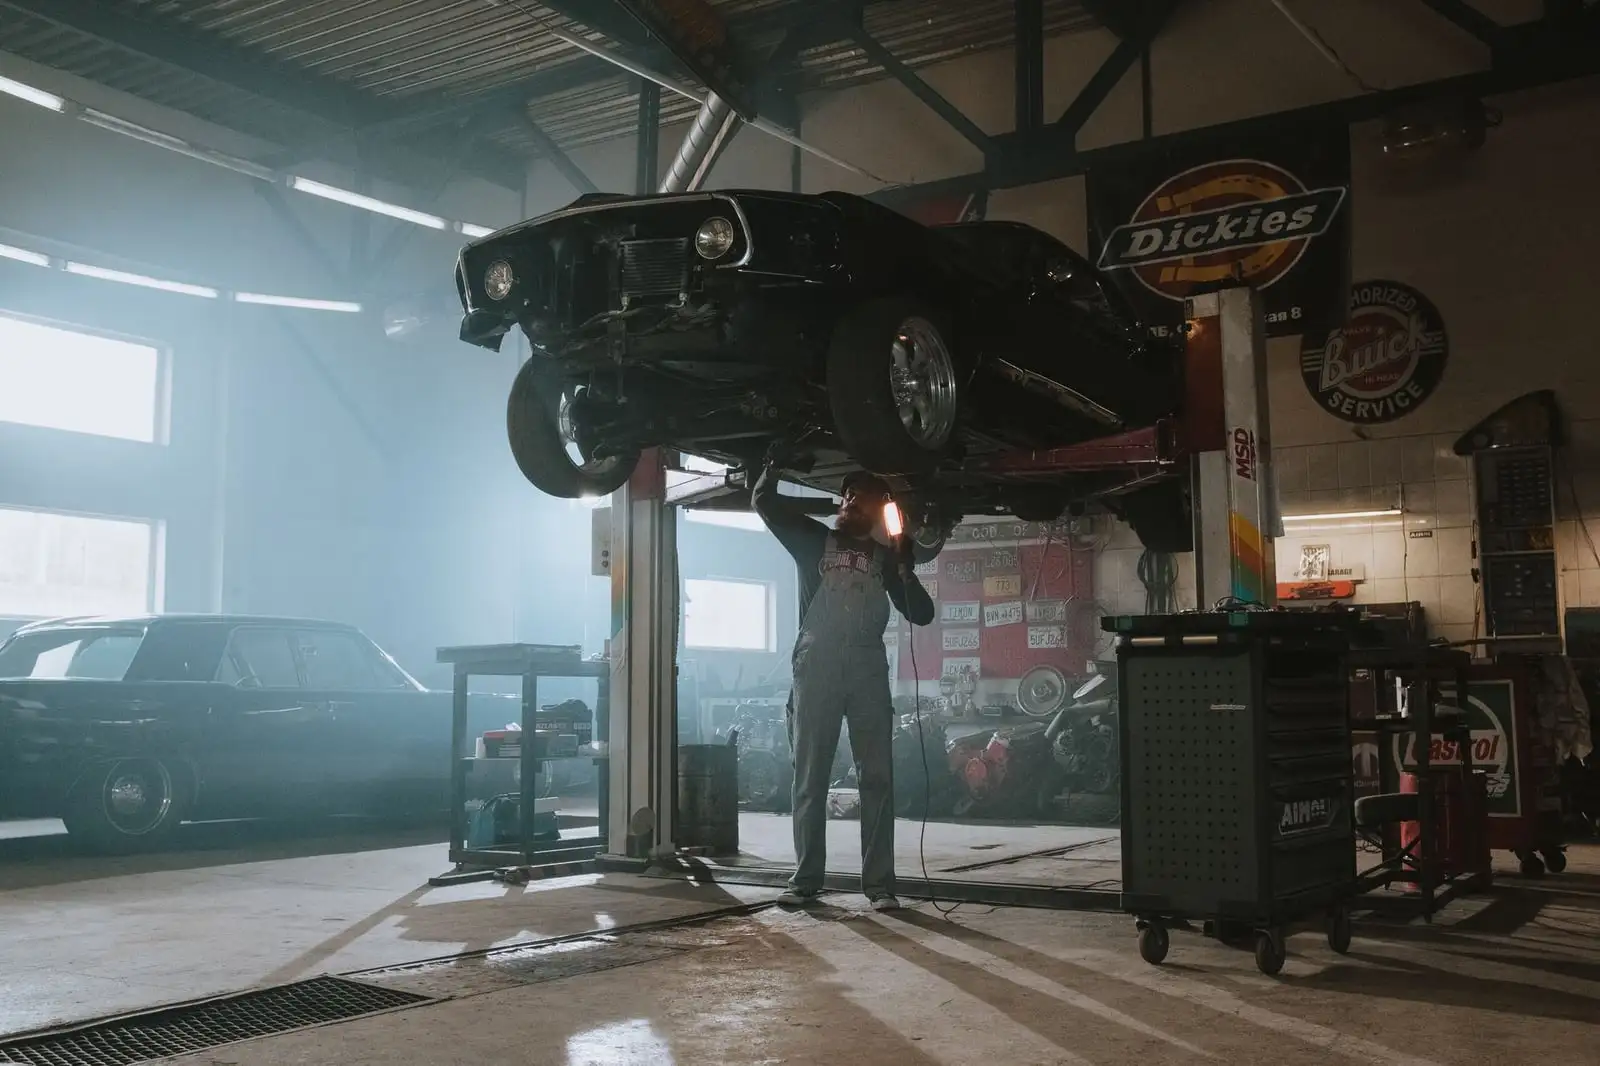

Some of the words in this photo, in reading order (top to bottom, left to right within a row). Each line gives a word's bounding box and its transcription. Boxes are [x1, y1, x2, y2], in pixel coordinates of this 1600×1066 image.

[1120, 204, 1319, 259] Dickies
[1291, 306, 1303, 319] 8
[1319, 311, 1427, 392] Buick
[1328, 380, 1424, 418] SERVICE
[1234, 428, 1251, 480] MSD
